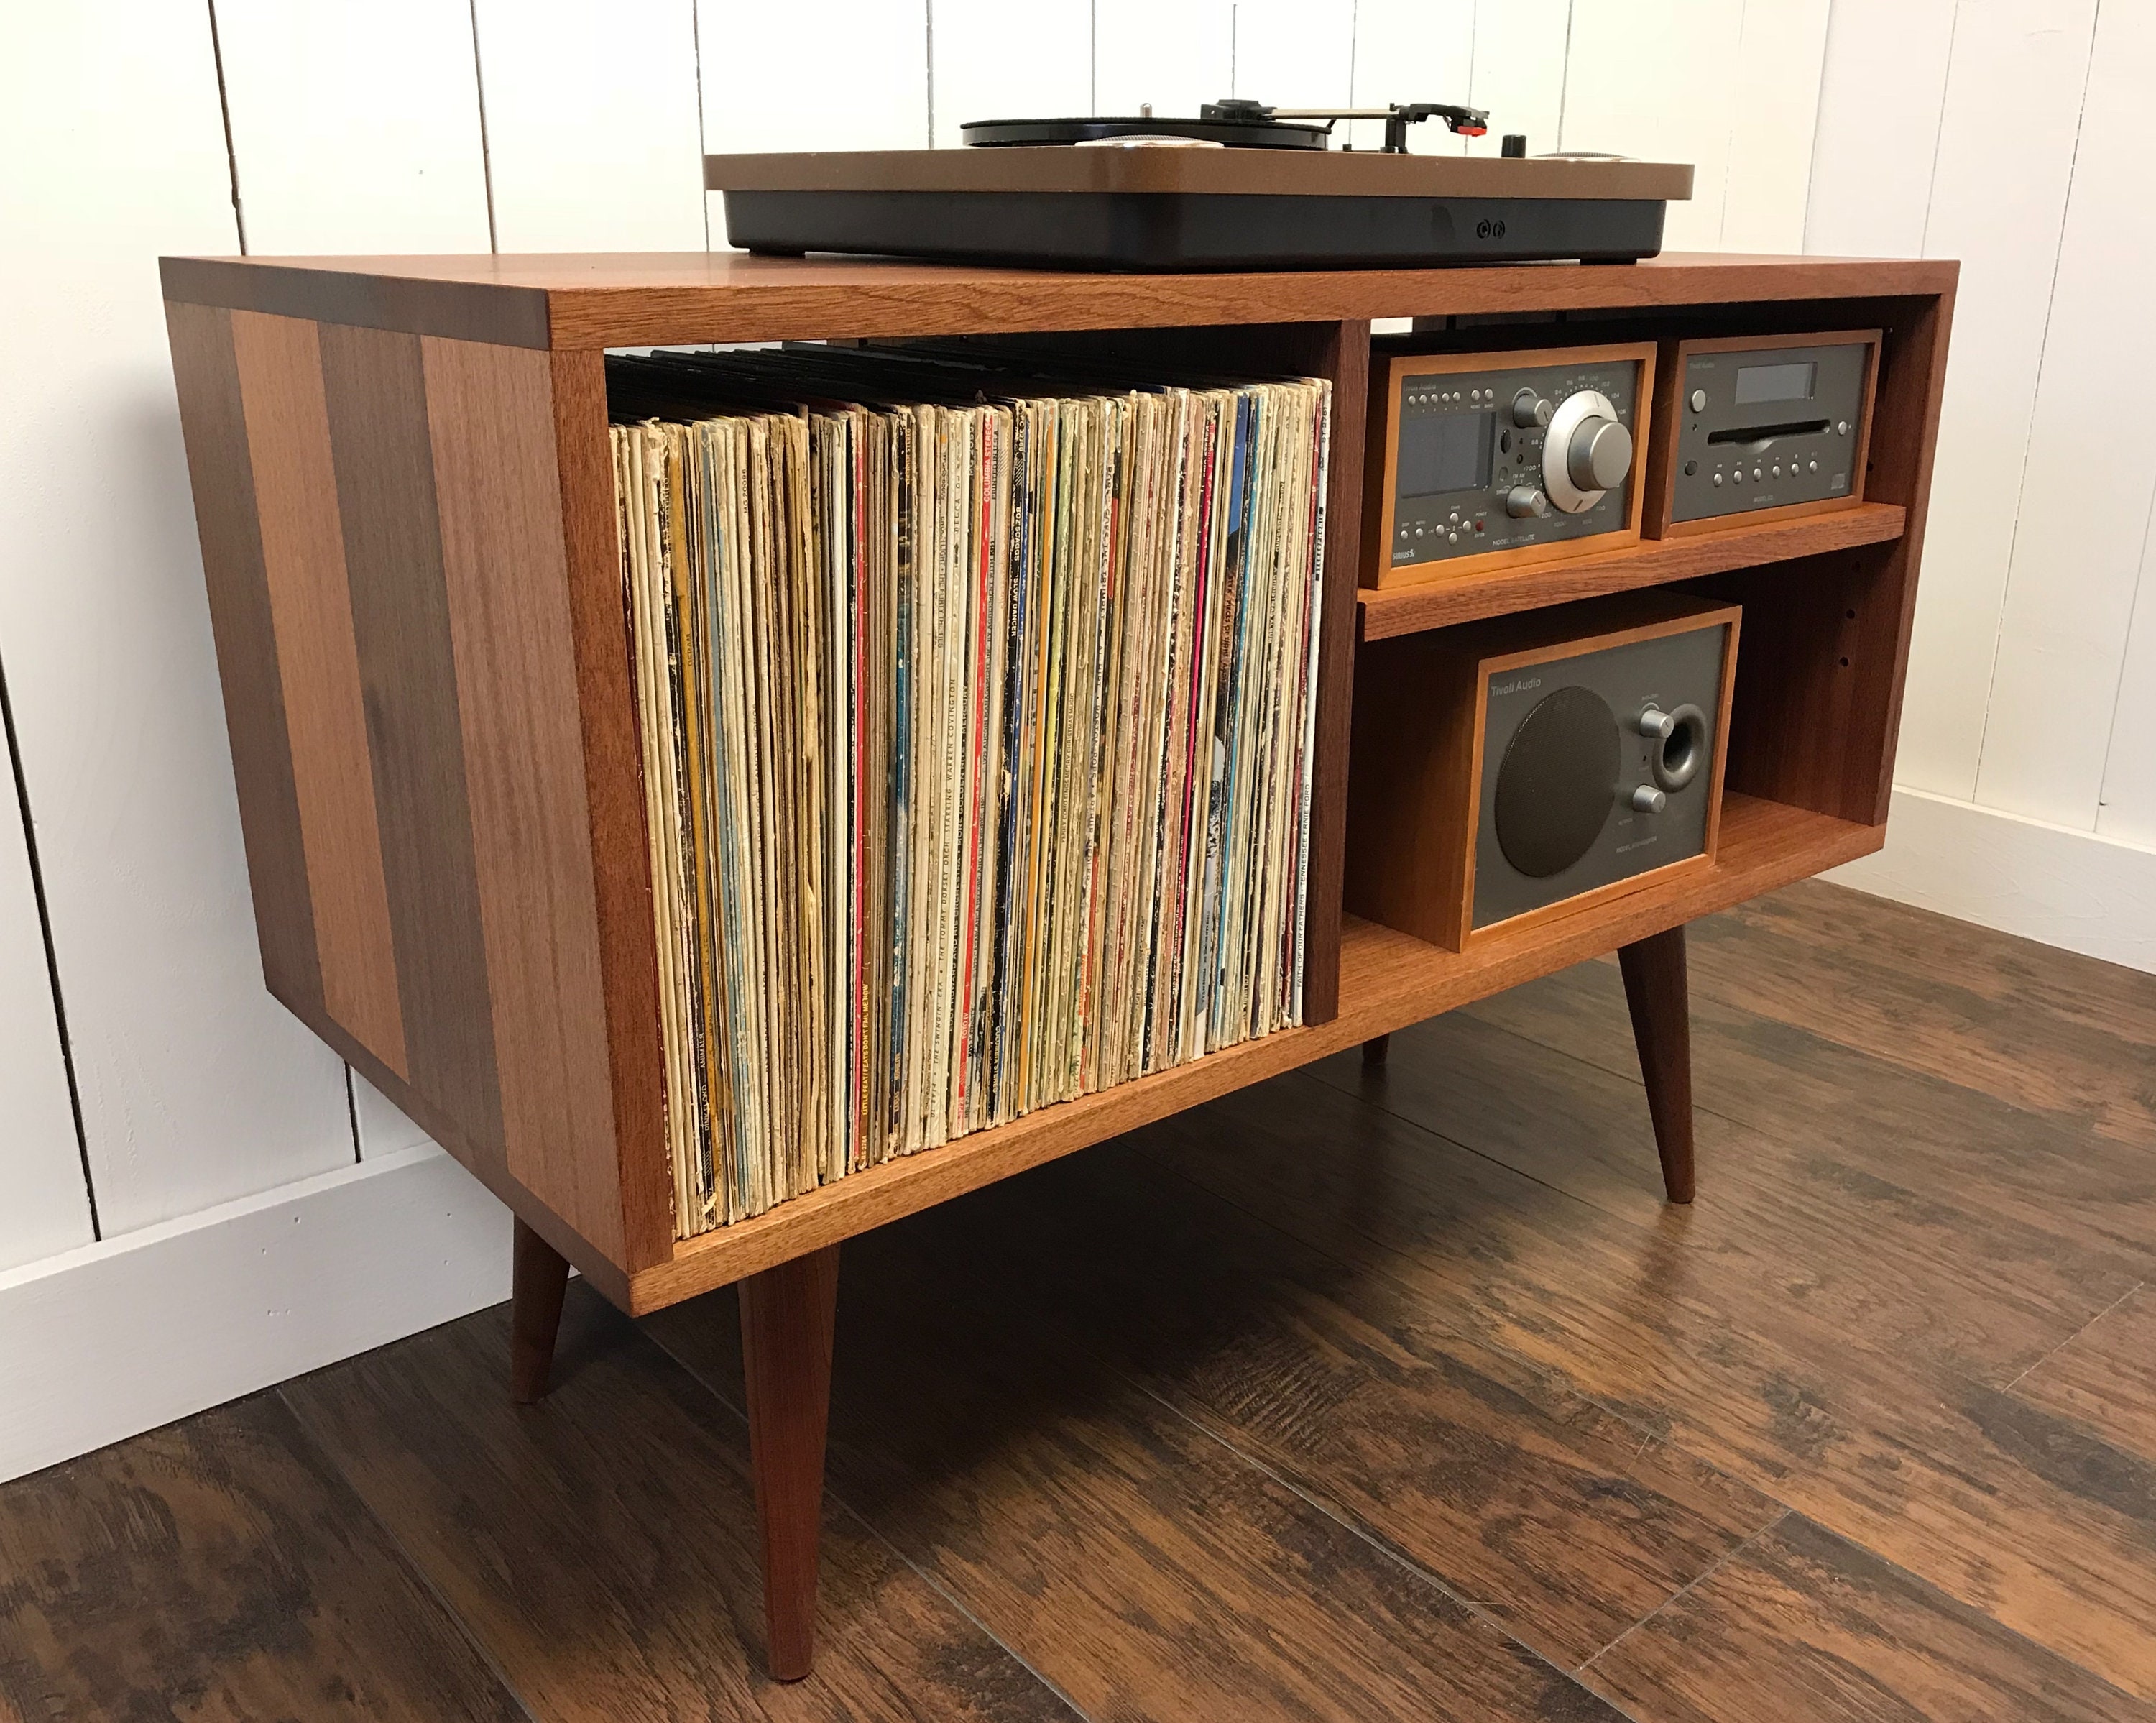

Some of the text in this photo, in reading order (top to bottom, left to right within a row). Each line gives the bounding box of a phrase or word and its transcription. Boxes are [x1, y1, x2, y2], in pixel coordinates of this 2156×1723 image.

[992, 452, 998, 461] IN
[742, 499, 749, 513] MG
[1393, 551, 1409, 560] SIRIUS
[1225, 625, 1230, 634] OF
[986, 633, 991, 642] BY
[1491, 678, 1541, 696] Tivoli Audio
[1296, 952, 1302, 962] OF
[862, 1001, 868, 1011] ME
